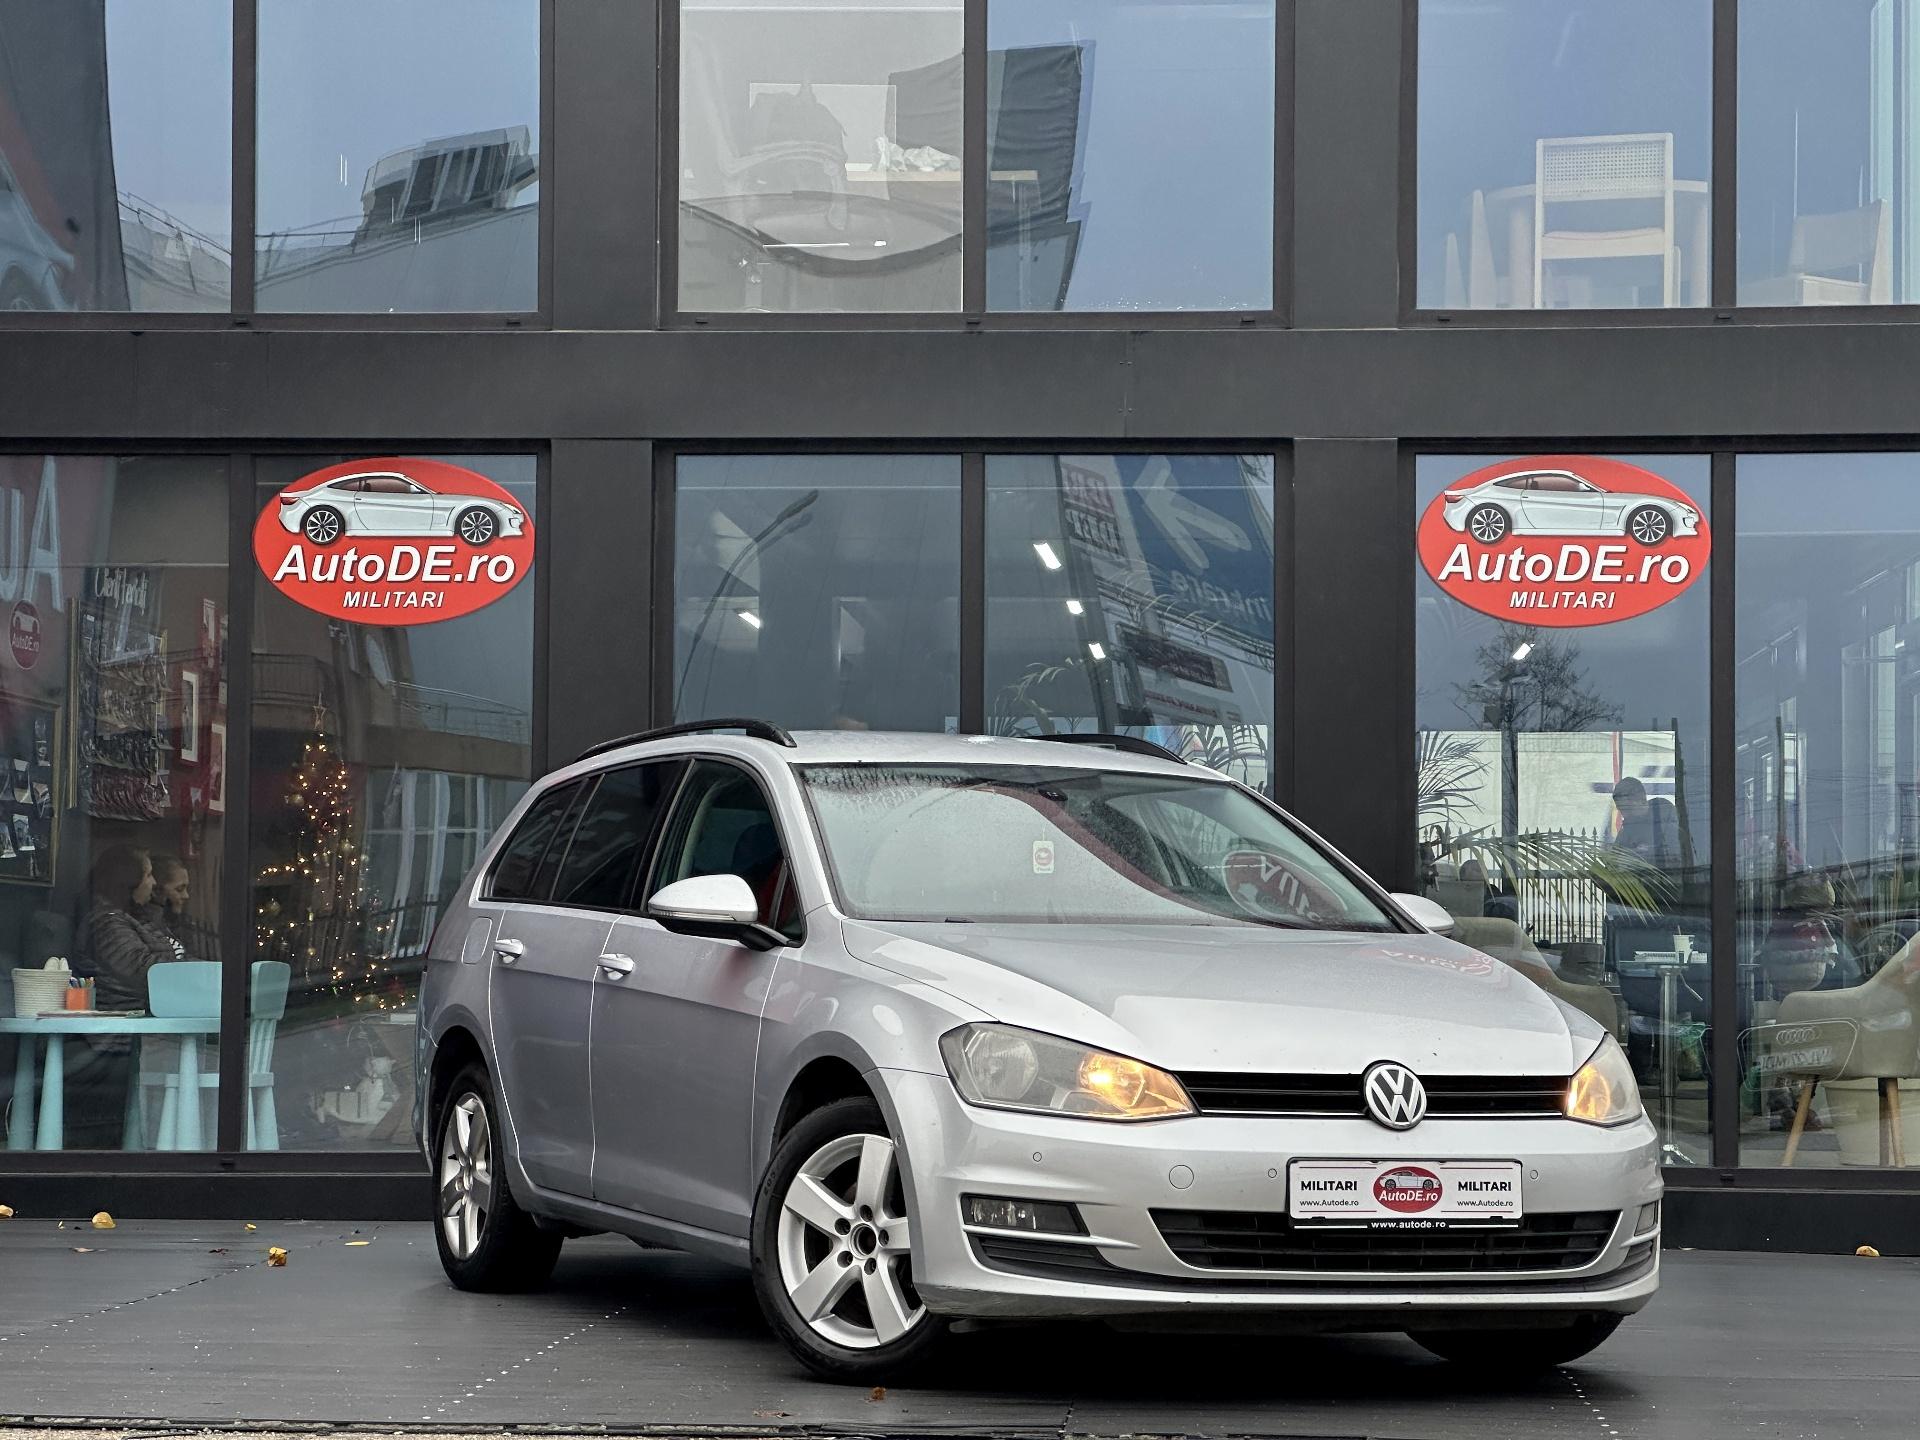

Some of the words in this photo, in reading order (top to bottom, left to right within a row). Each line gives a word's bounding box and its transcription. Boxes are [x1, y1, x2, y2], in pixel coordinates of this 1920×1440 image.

[272, 544, 516, 583] AutoDE.ro
[1437, 543, 1691, 584] AutoDE.ro
[342, 590, 445, 608] MILITARI
[1509, 590, 1616, 609] MILITARI
[1300, 1180, 1358, 1191] MILITARI
[1457, 1181, 1512, 1192] MILITARI
[1378, 1190, 1439, 1202] AutoDE.ro
[1299, 1199, 1360, 1207] www.Autode.ro
[1456, 1199, 1514, 1207] www.Autode.ro
[1370, 1220, 1446, 1229] www.autode.ro
